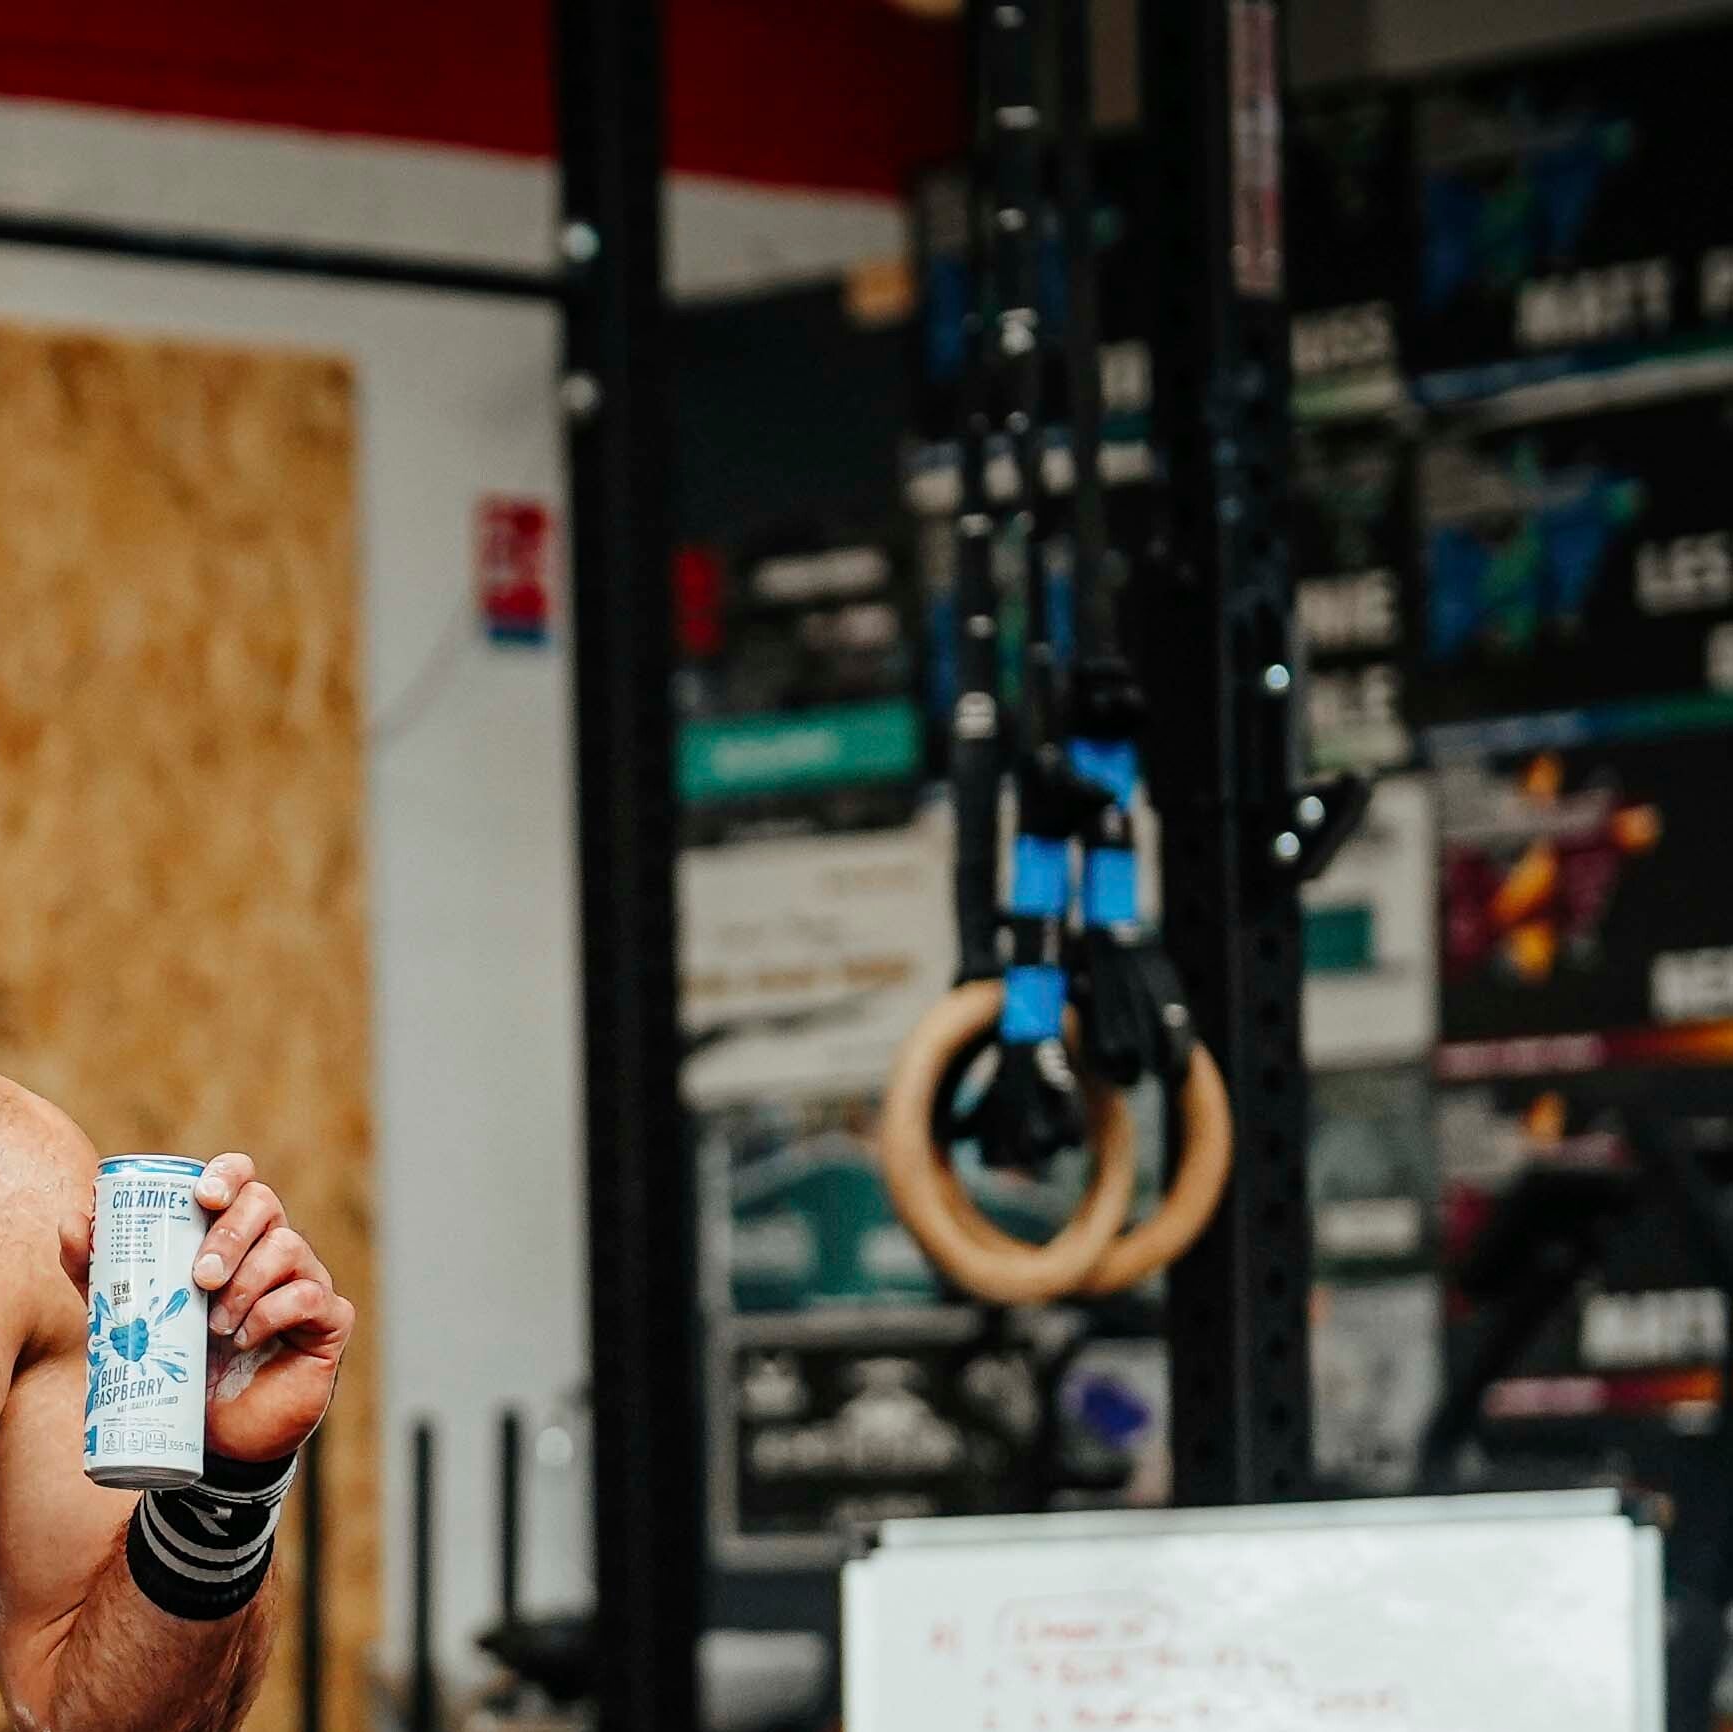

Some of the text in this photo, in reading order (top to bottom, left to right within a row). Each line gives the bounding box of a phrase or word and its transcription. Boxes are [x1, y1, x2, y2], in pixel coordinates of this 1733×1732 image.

[112, 1189, 178, 1209] CREATINE
[101, 1363, 130, 1389] BLUE
[94, 1376, 165, 1410] RASPBERRY
